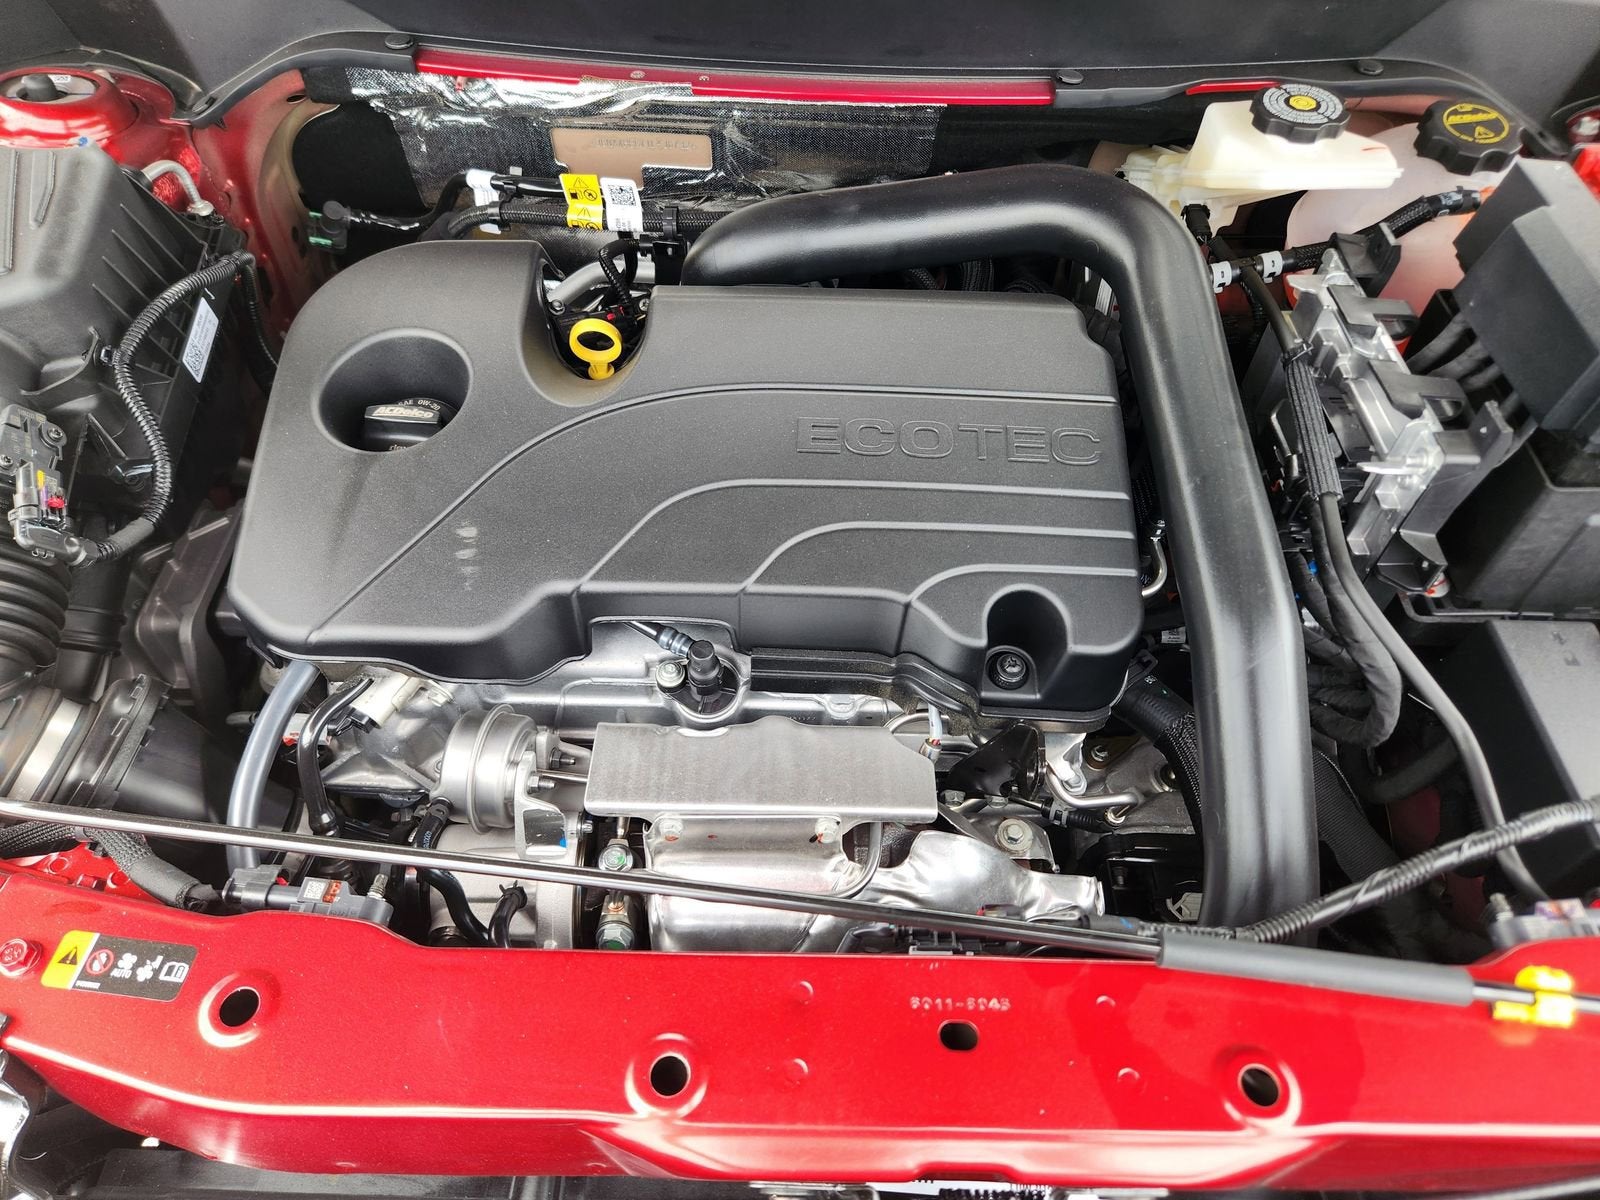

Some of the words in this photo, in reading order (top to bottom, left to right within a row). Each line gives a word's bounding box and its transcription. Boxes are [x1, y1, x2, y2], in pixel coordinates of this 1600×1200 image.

[417, 399, 441, 411] 0W-20
[372, 406, 434, 419] ACDelco
[797, 417, 1100, 465] ECOTEC
[110, 968, 133, 979] AUTO
